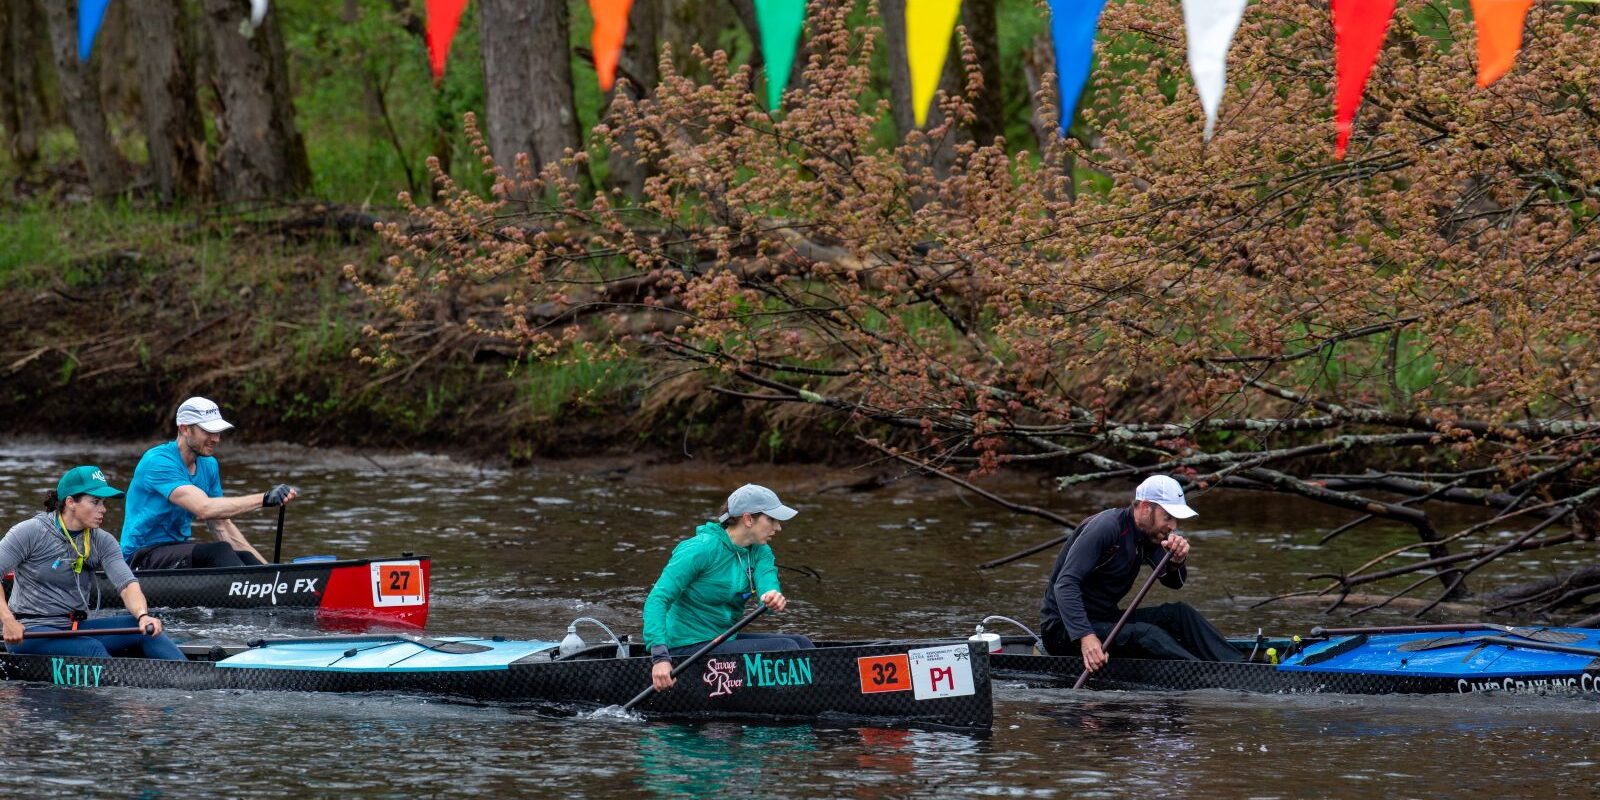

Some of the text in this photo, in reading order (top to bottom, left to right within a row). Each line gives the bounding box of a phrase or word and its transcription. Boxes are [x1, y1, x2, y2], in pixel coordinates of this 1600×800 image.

[228, 571, 318, 605] Ripple FX
[389, 570, 410, 590] 27
[51, 657, 103, 688] KELLY
[703, 658, 737, 686] Savage
[743, 653, 813, 687] MEGAN
[871, 662, 898, 685] 32
[929, 666, 955, 692] P1
[709, 671, 743, 698] River
